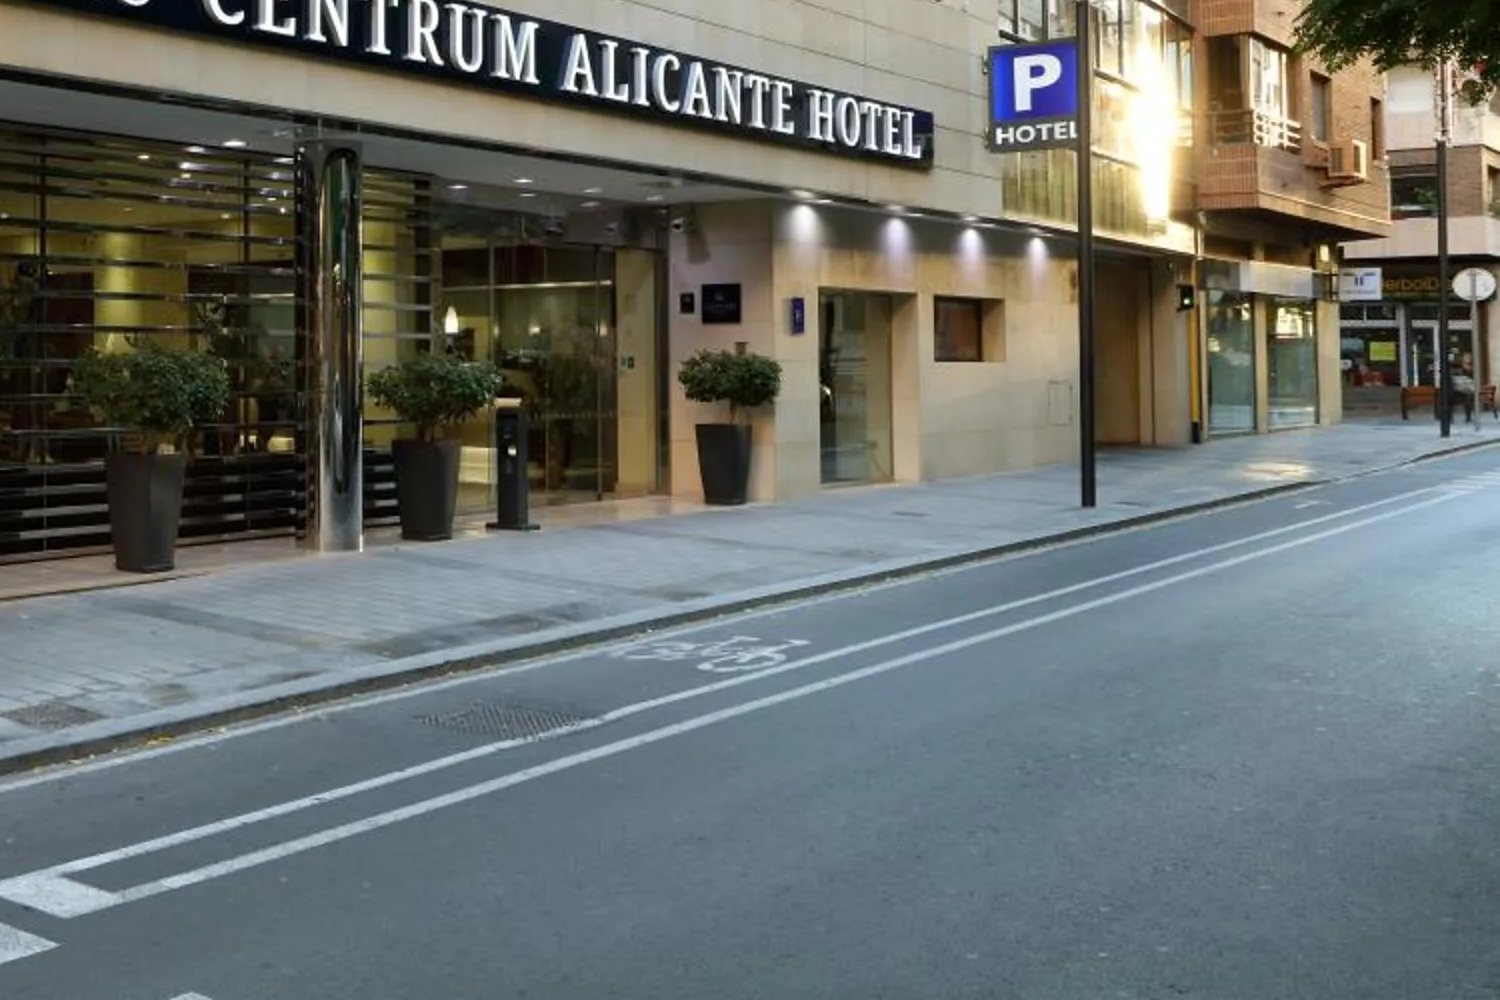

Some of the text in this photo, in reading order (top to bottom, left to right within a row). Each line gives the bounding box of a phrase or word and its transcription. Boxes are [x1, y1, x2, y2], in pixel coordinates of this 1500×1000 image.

[558, 31, 795, 136] ALICANTE
[804, 89, 923, 160] HOTEL
[1013, 53, 1062, 113] P
[995, 121, 1078, 146] HOTEL
